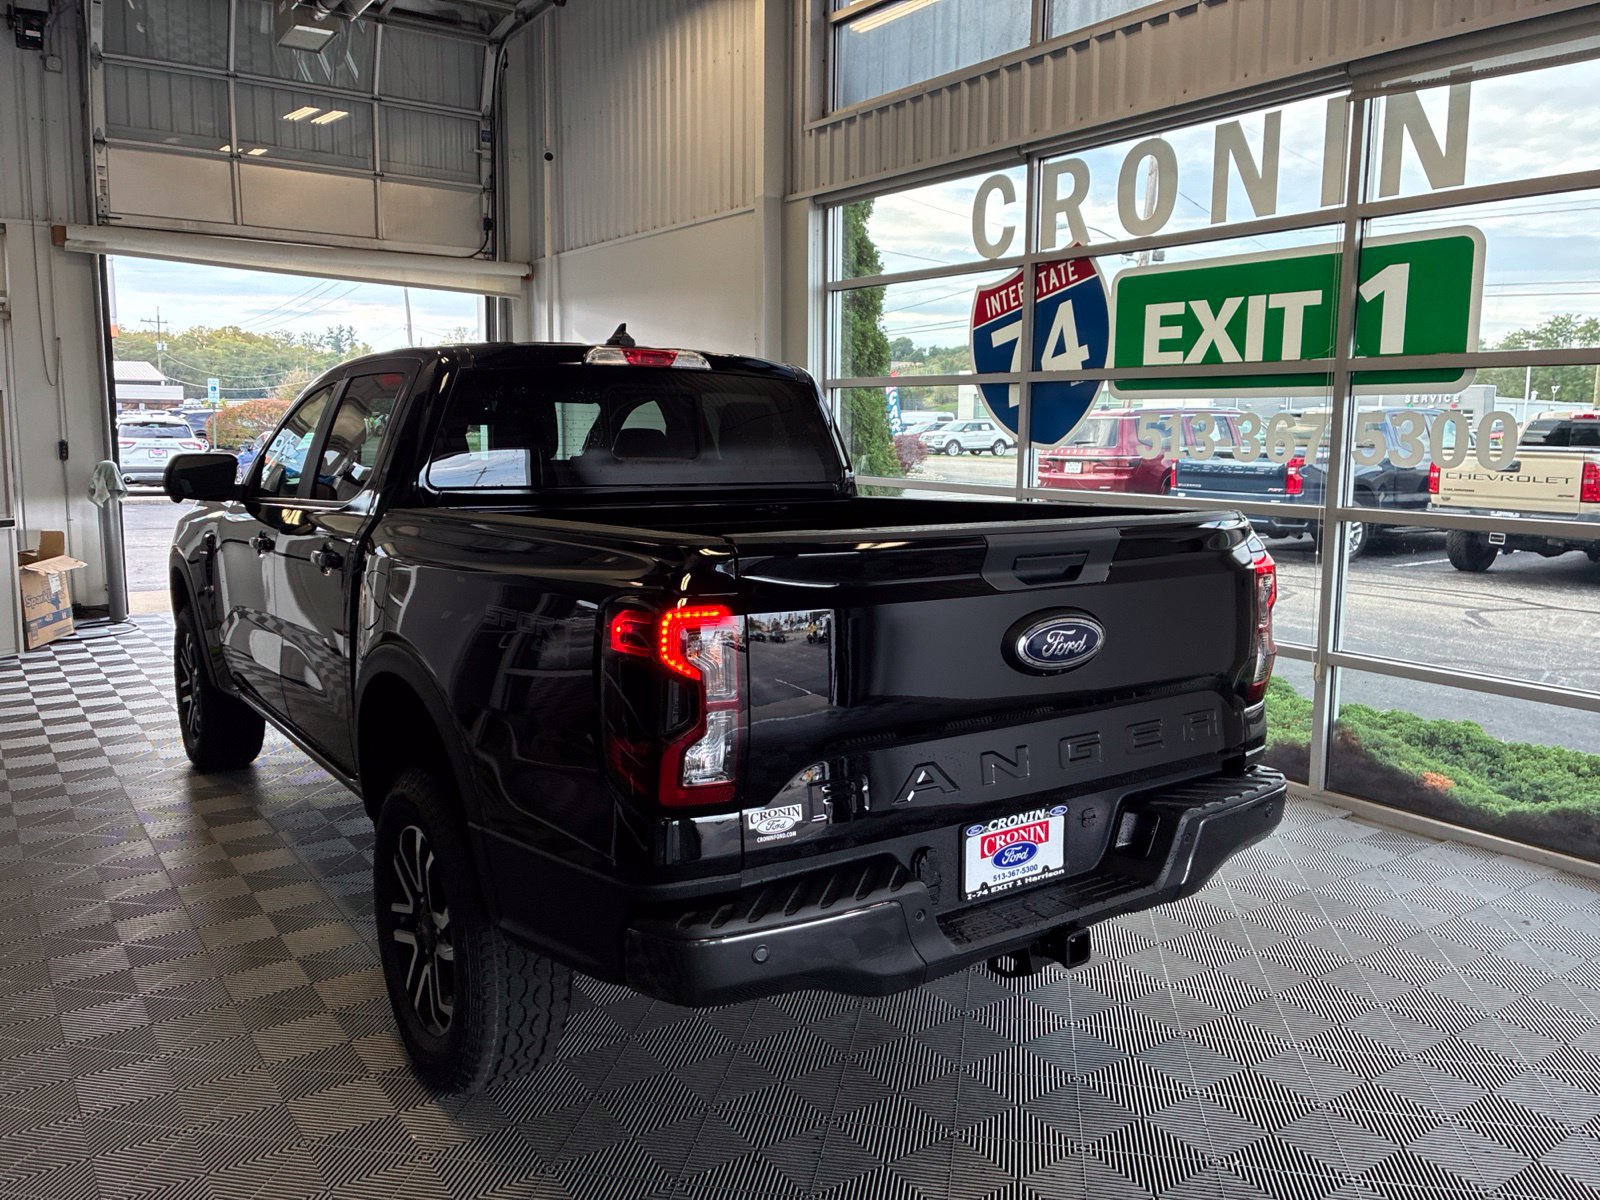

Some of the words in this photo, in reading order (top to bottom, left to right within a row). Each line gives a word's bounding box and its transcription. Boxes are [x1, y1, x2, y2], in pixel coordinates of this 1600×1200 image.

[972, 66, 1473, 258] CRONIN
[985, 260, 1079, 318] INTERTATE
[1143, 290, 1323, 365] EXIT
[1359, 263, 1410, 354] 1
[991, 299, 1090, 408] 74
[1404, 394, 1461, 404] SERVICE
[1135, 410, 1518, 469] 513-3675300
[1445, 472, 1574, 485] CHEVROLET
[1042, 629, 1087, 657] Ford
[749, 804, 801, 825] CRONIN
[765, 819, 787, 832] Ford
[988, 808, 1046, 831] CRONIN
[756, 830, 797, 843] CRONINFORD.COM
[983, 824, 1047, 856] CRONIN
[1001, 845, 1029, 865] Ford
[967, 888, 989, 900] I-74
[990, 881, 1014, 893] EXIT
[1025, 868, 1065, 883] Harrison
[992, 864, 1039, 882] 513-367-5300
